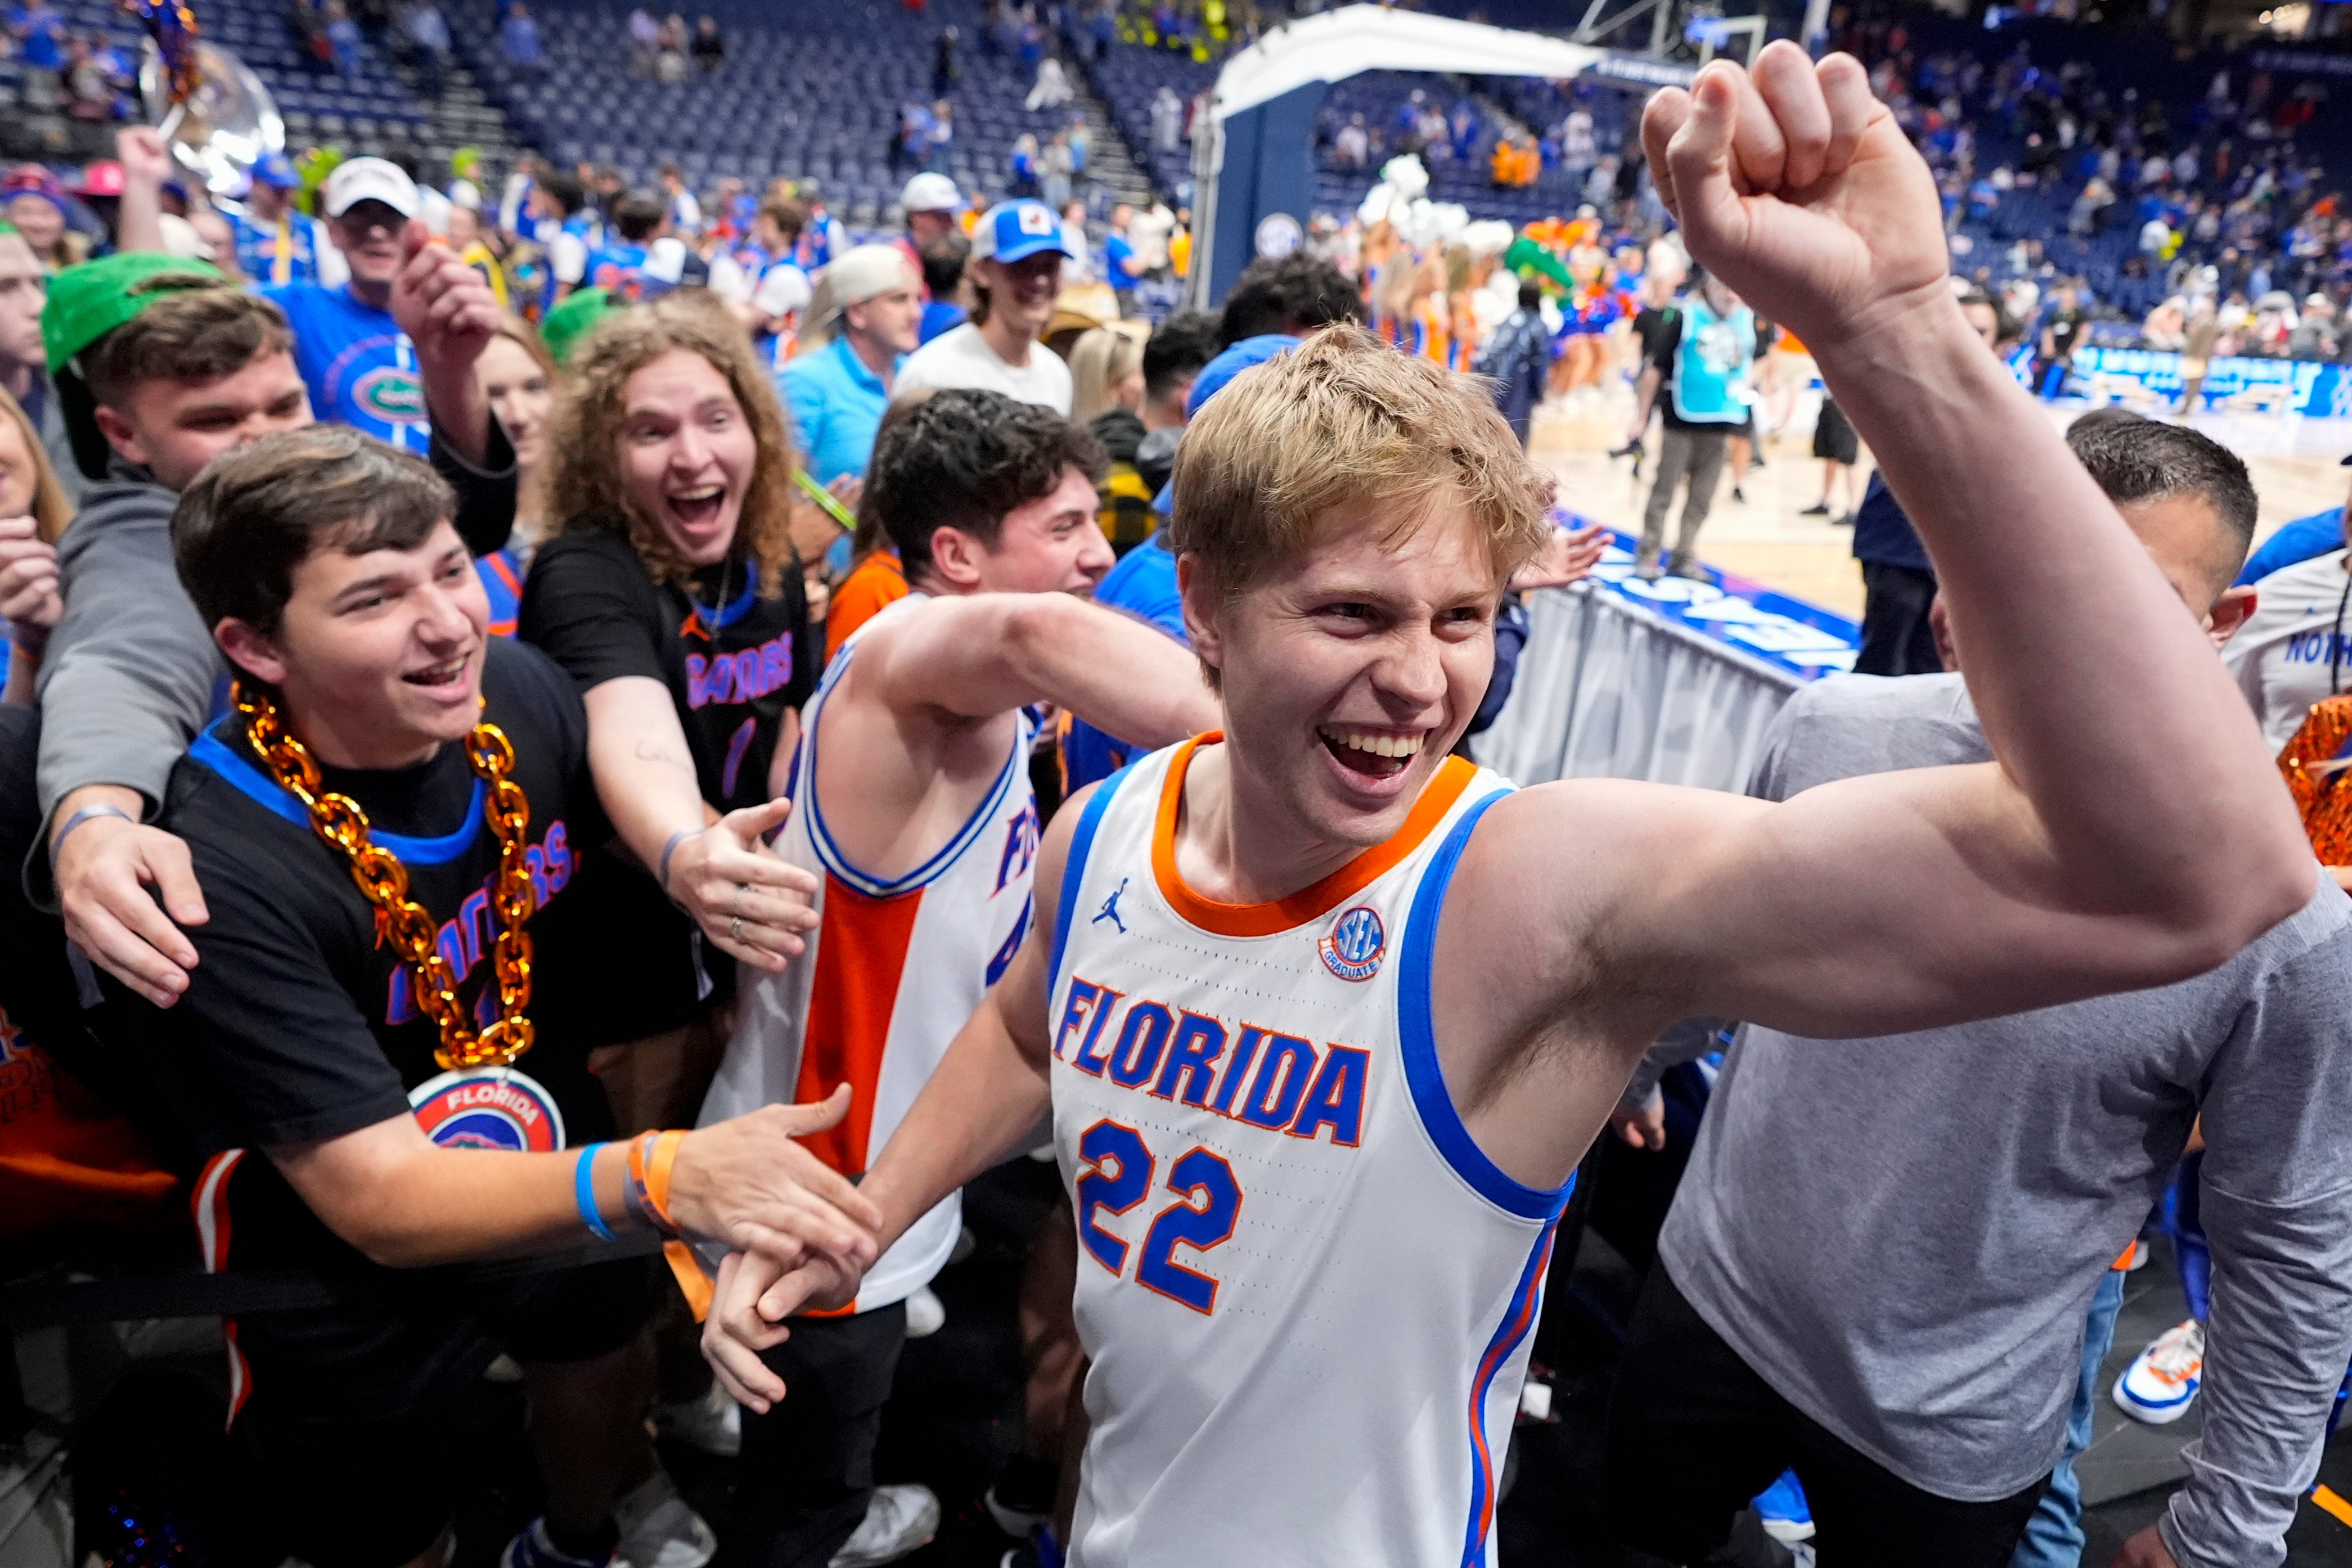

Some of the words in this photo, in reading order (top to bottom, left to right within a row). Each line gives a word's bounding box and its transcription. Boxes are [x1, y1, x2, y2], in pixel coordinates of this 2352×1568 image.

[1337, 909, 1380, 961] SEC
[1324, 950, 1378, 979] GRADUATE
[1051, 975, 1371, 1148] FLORIDA
[446, 1085, 541, 1127] FLORIDA
[1076, 1118, 1244, 1316] 22
